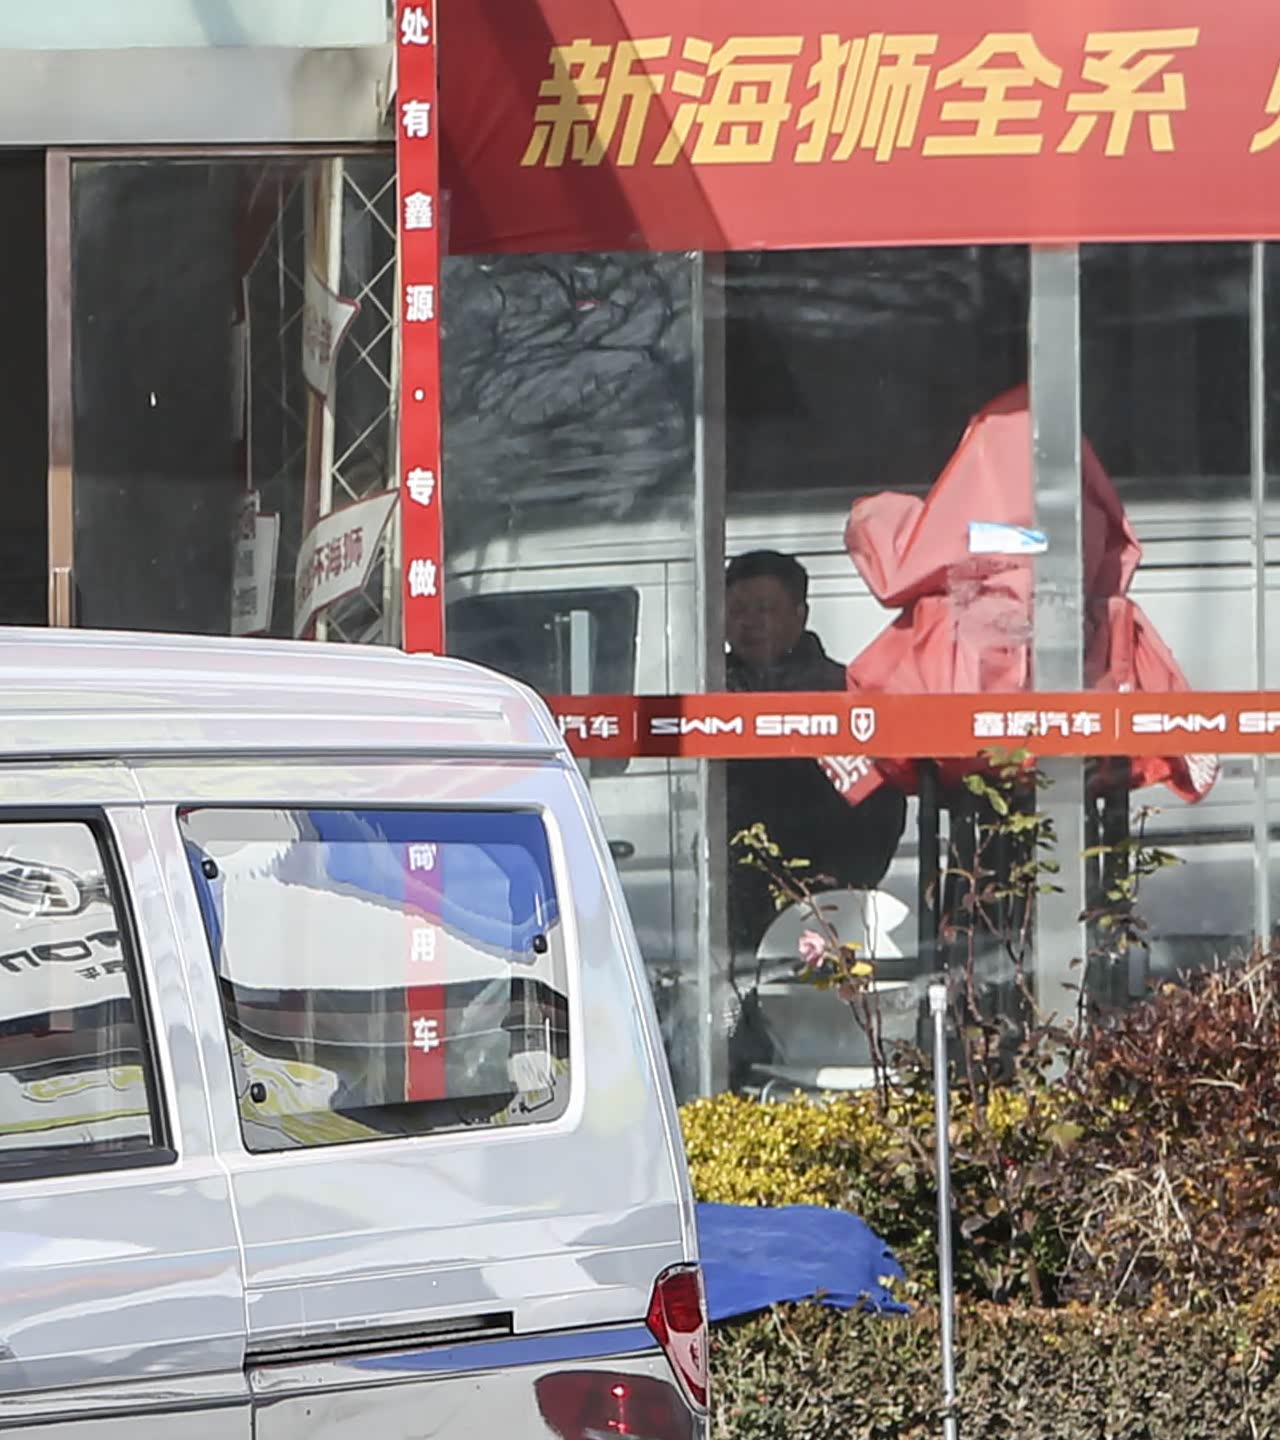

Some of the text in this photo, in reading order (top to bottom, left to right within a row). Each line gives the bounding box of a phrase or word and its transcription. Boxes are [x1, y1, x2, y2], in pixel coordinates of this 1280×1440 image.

[520, 27, 1200, 168] 新海狮全系
[650, 716, 742, 735] SWM
[755, 714, 838, 737] SRM
[1132, 713, 1227, 733] SWM
